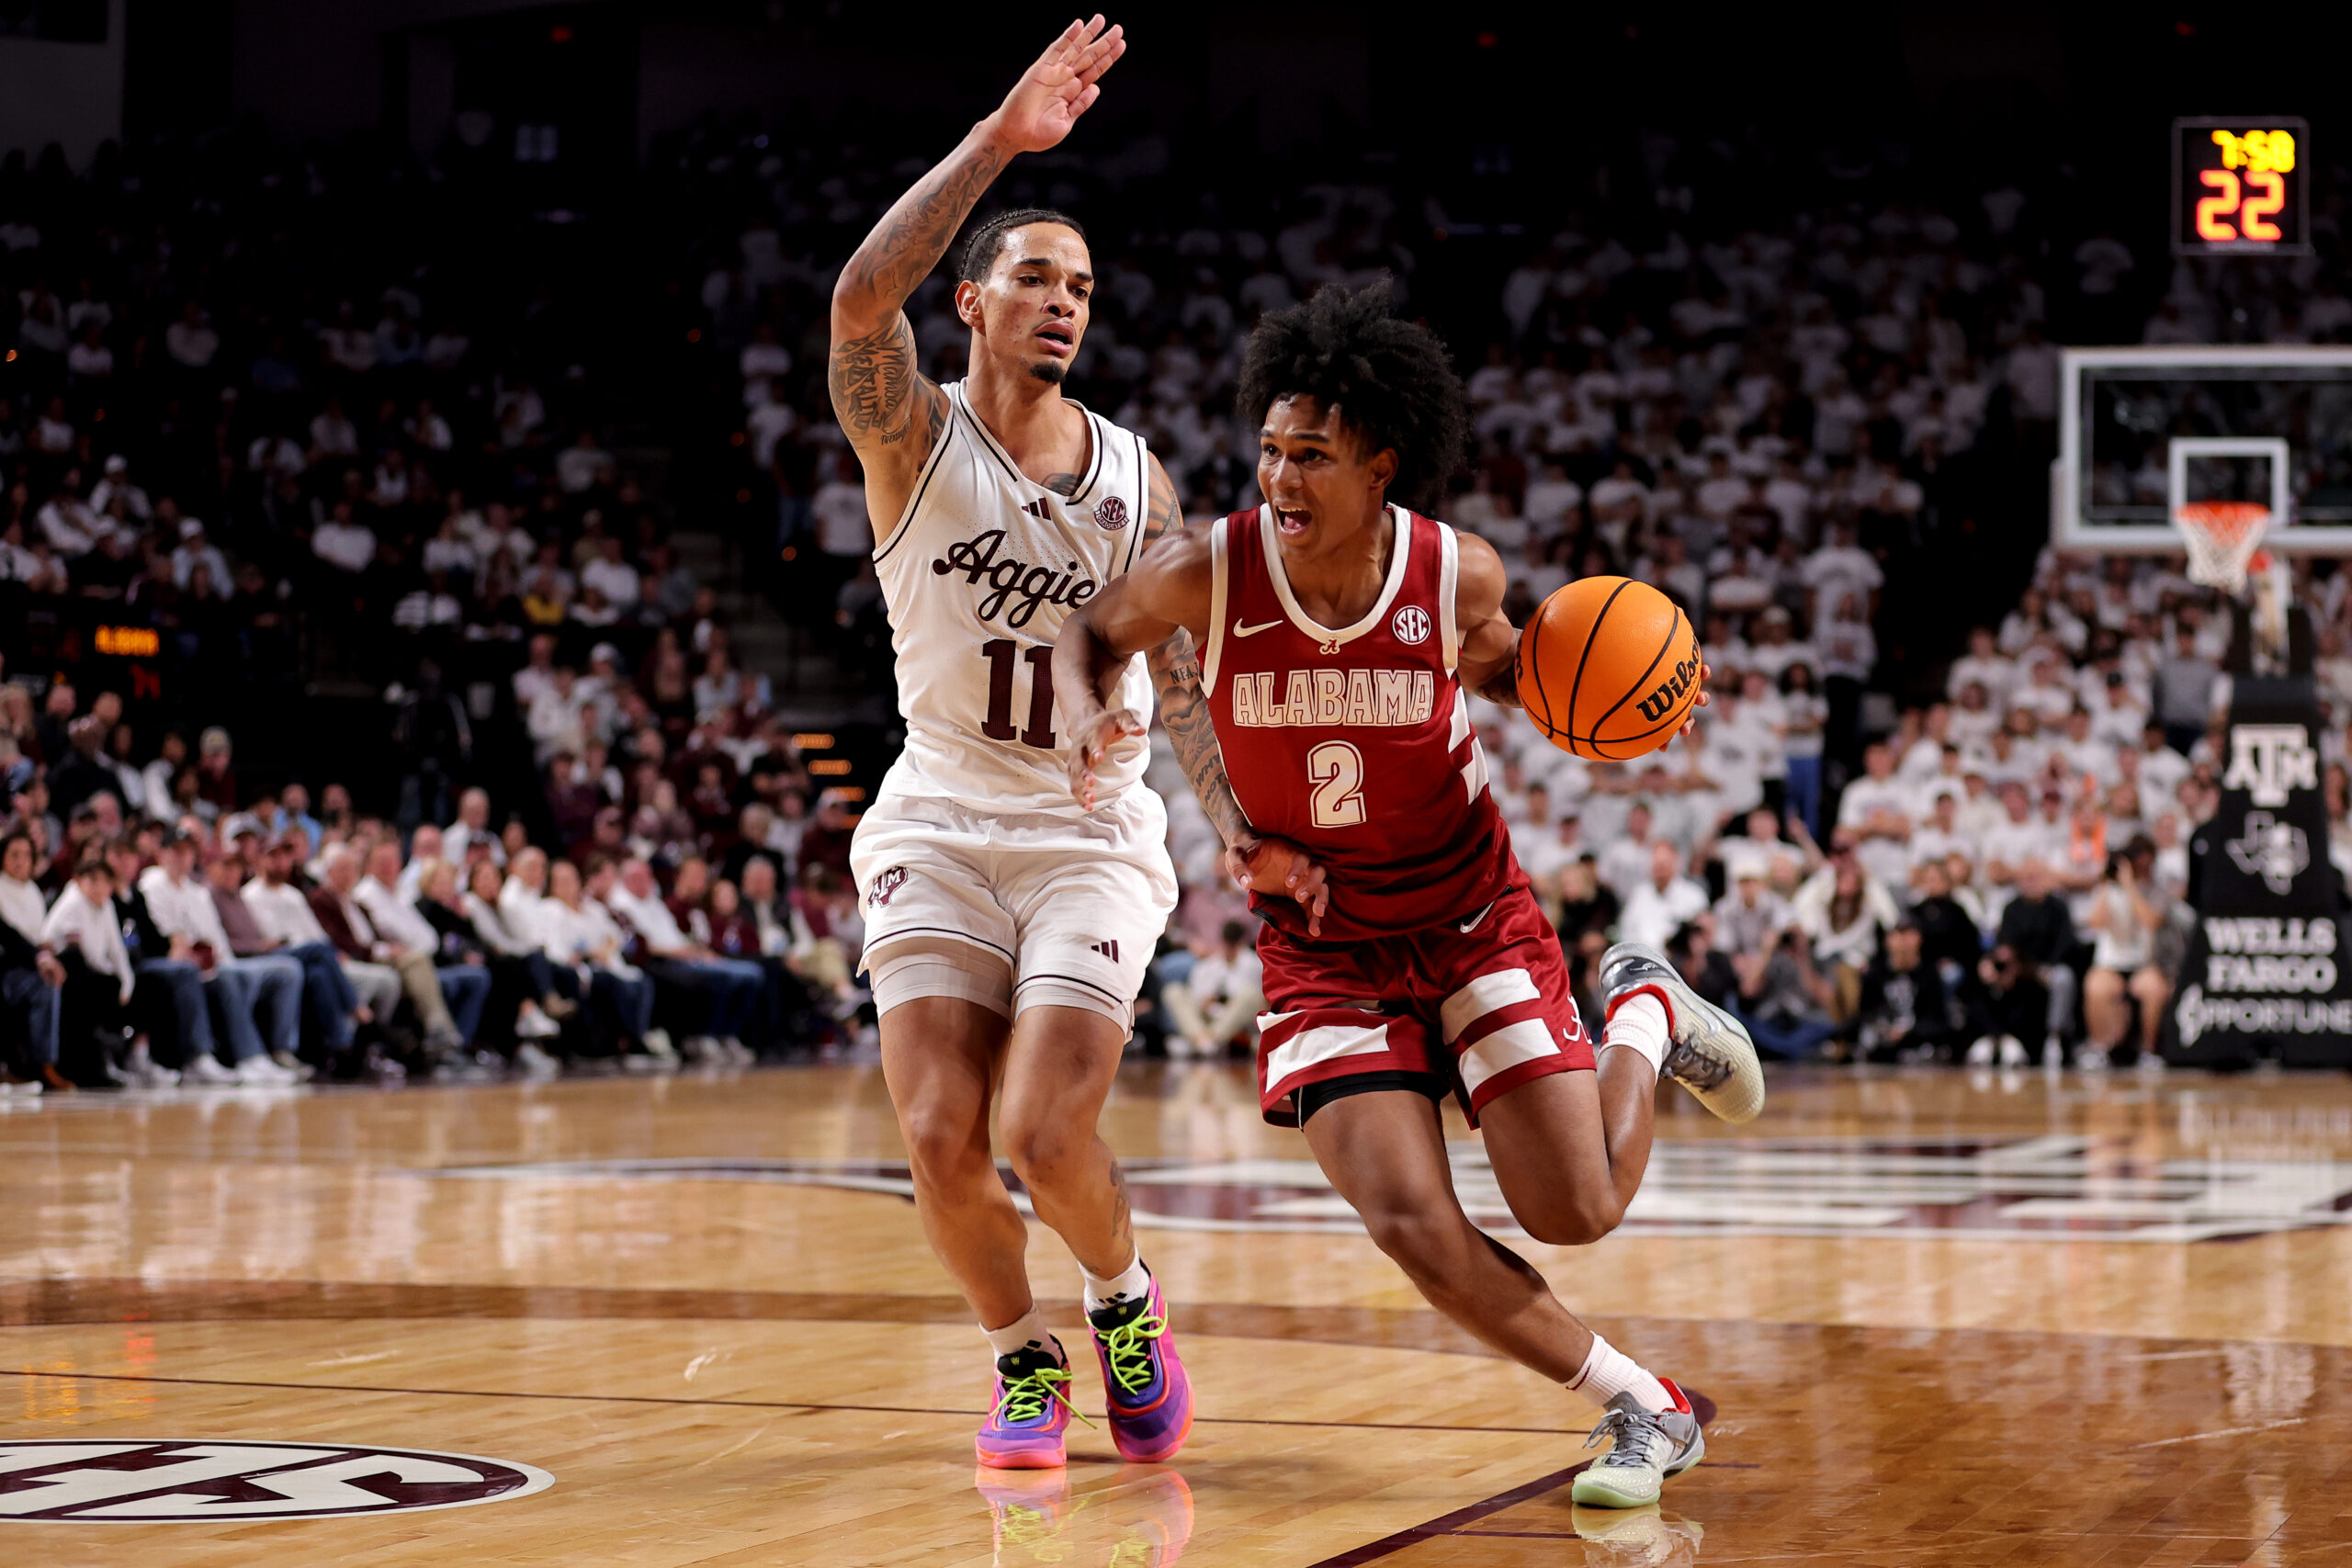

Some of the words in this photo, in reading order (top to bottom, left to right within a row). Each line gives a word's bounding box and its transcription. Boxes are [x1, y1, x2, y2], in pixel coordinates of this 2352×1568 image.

[2196, 169, 2285, 241] 22
[1102, 498, 1125, 521] SEC
[933, 530, 1105, 628] Aggie
[1396, 608, 1428, 642] SEC
[981, 638, 1057, 749] 11
[1232, 669, 1434, 728] ALABAMA
[1635, 643, 1699, 722] Wilso
[1306, 739, 1367, 829] 2
[2204, 917, 2337, 955] WELLS
[2207, 954, 2337, 994] FARGO
